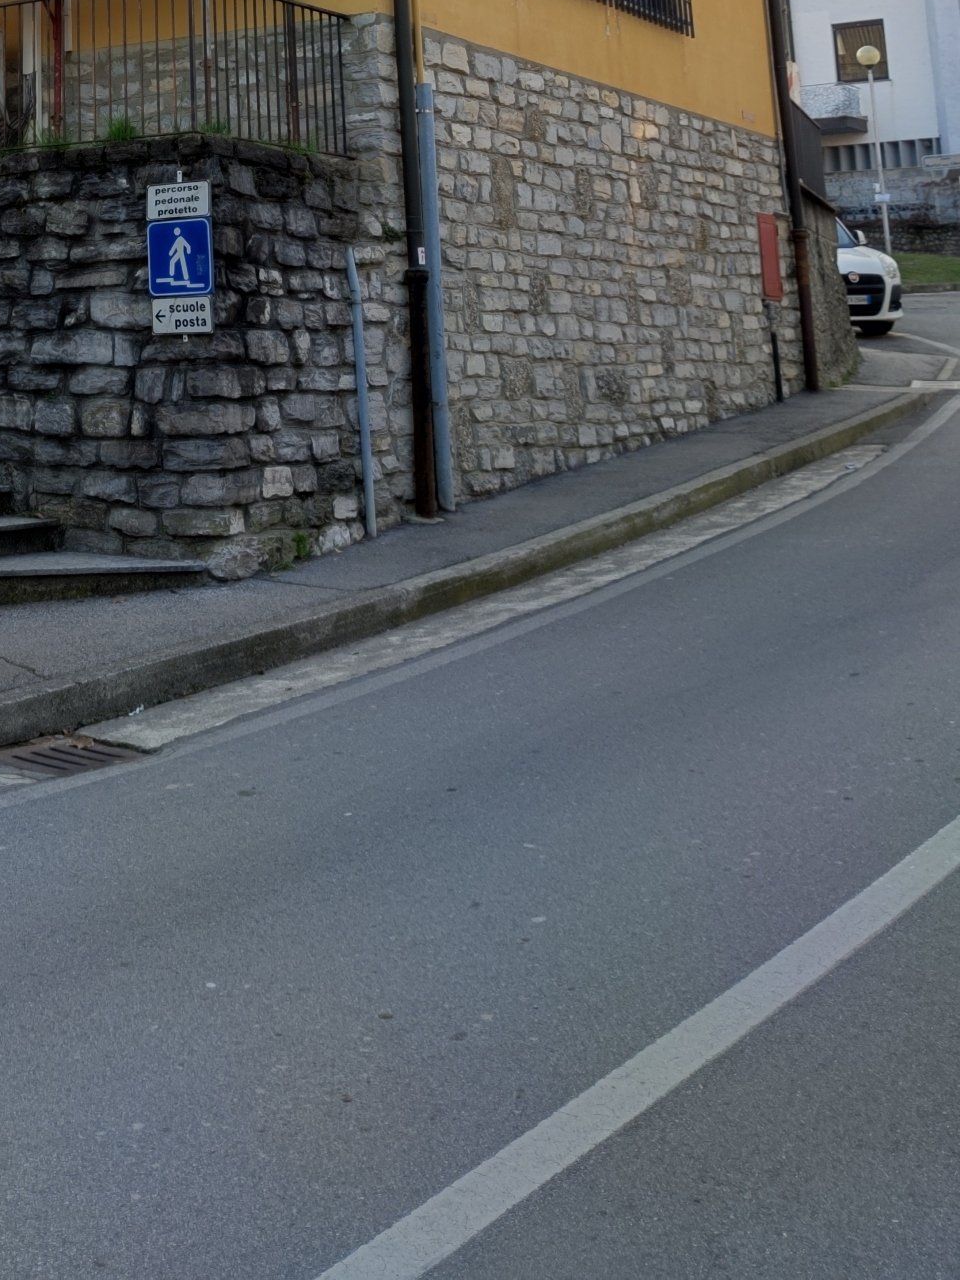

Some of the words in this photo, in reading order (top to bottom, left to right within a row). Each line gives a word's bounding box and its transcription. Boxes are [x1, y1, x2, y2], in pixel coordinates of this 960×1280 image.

[155, 185, 199, 196] percorso
[155, 195, 200, 206] pedonale
[157, 206, 198, 217] protetto
[169, 300, 207, 314] scuole
[174, 316, 207, 330] posta
